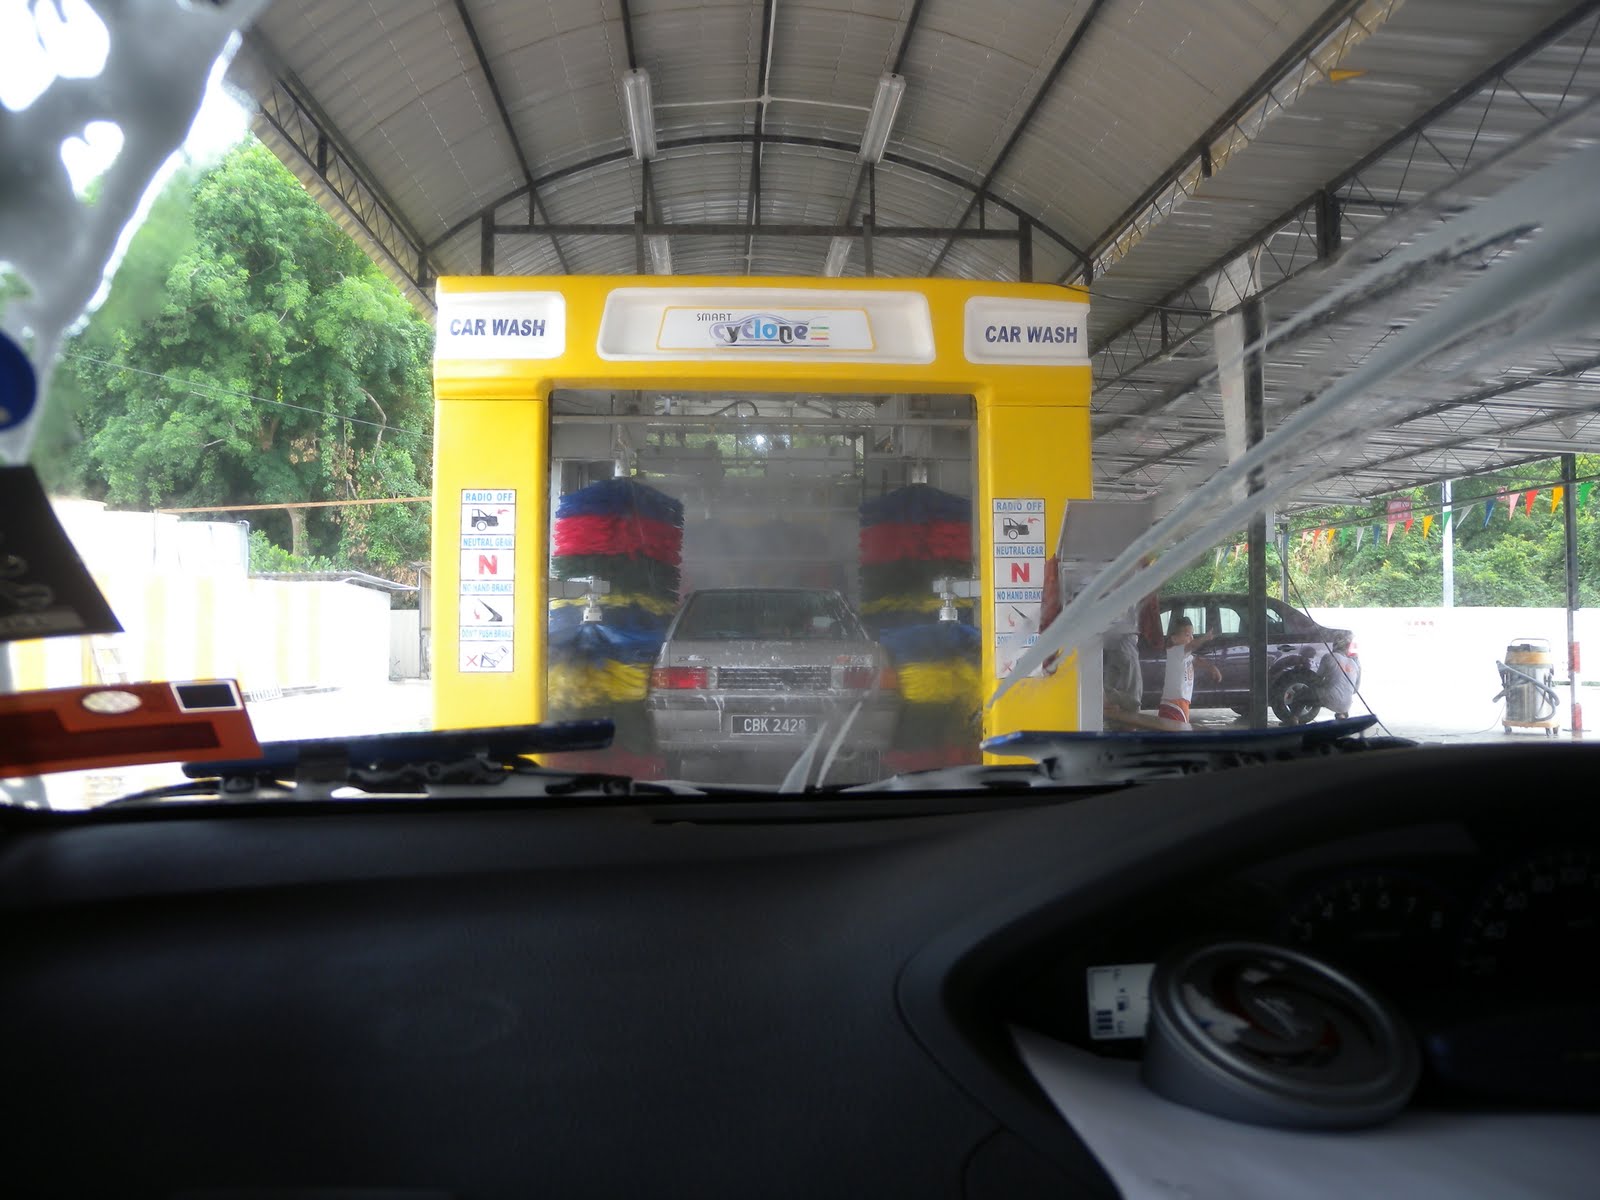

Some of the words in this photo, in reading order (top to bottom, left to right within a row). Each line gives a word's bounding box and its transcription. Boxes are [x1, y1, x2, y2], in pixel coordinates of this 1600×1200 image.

[697, 312, 732, 322] SMART
[449, 319, 486, 337] CAR
[491, 318, 546, 337] WASH
[985, 325, 1021, 344] CAR
[1027, 325, 1078, 344] WASH
[465, 492, 493, 502] RADIO
[496, 492, 513, 502] OFF
[996, 501, 1023, 511] RADIO
[1026, 501, 1043, 511] OFF
[463, 537, 493, 547] NEUTRAL
[495, 537, 513, 547] GEAR
[996, 546, 1026, 556] NEUTRAL
[1027, 546, 1044, 556] GEAR
[479, 554, 498, 575] N
[1011, 562, 1030, 583] N
[491, 583, 513, 593] BRAKE
[996, 591, 1006, 600] NO
[1006, 591, 1023, 600] HAND
[743, 718, 769, 732] CBK
